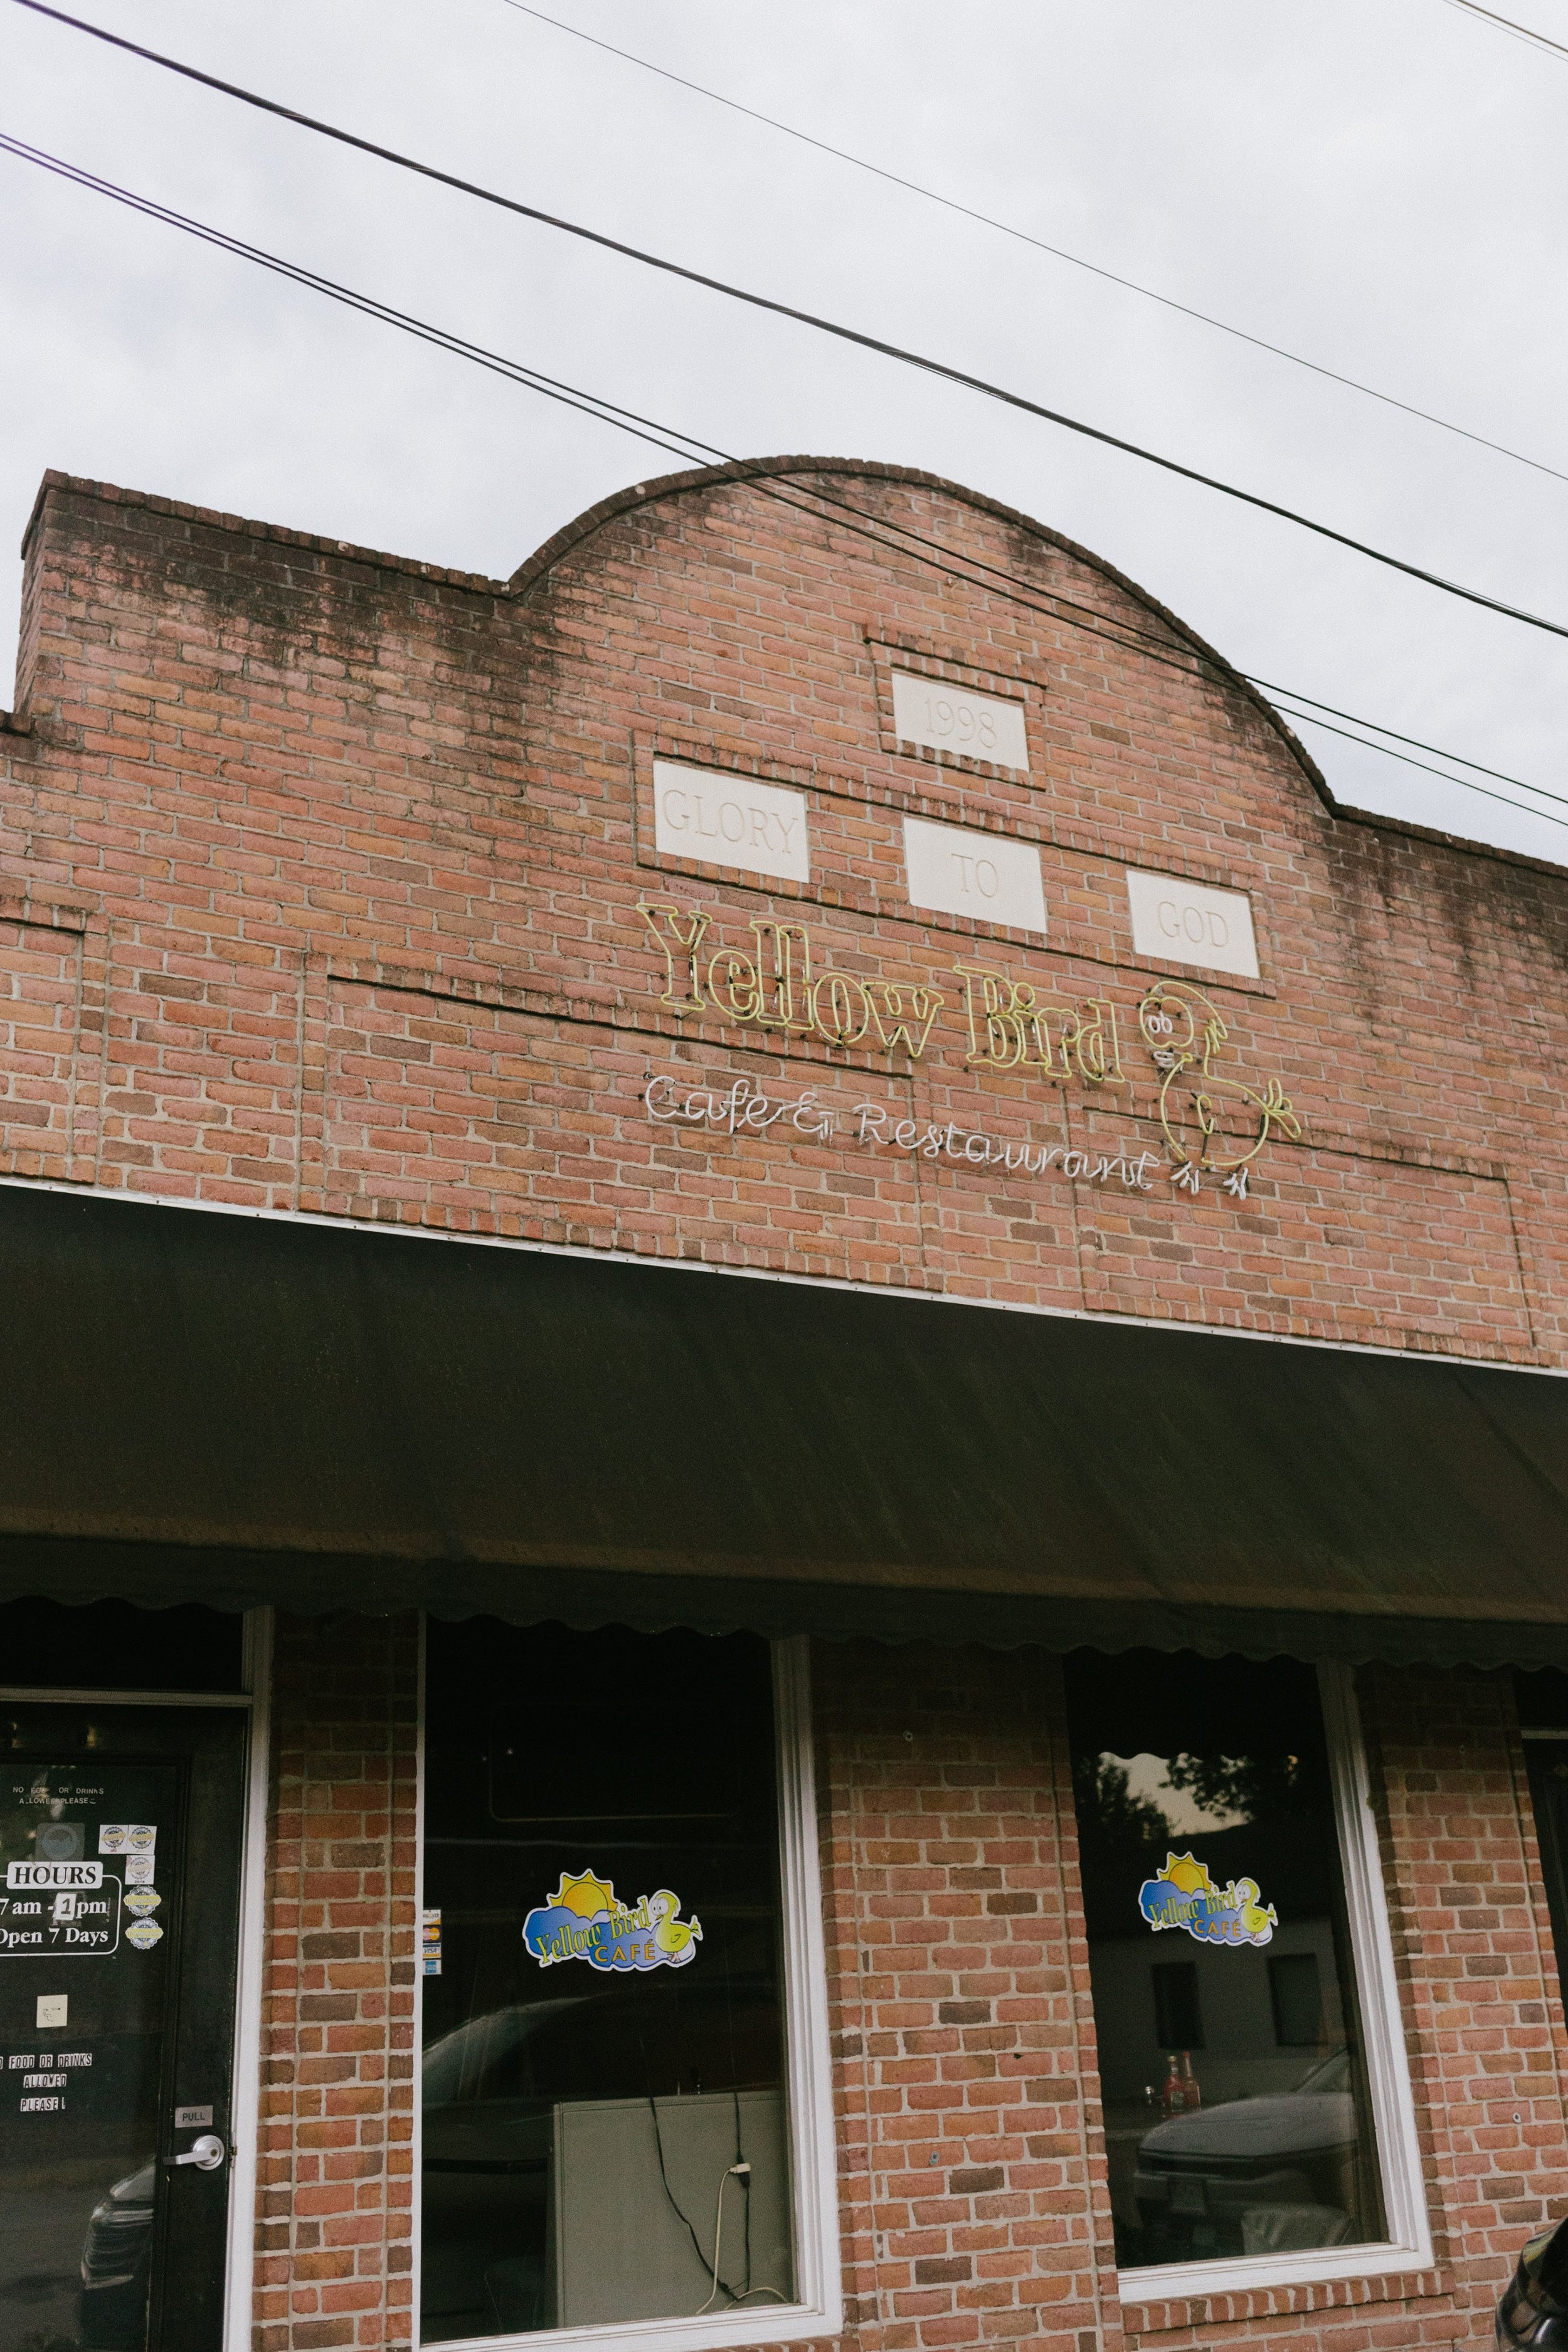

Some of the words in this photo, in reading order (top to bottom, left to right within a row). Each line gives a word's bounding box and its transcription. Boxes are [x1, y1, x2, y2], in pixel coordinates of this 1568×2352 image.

[924, 697, 997, 750] 1998
[662, 788, 799, 855] GLORY
[950, 852, 999, 899] TO
[1158, 899, 1229, 949] GOD
[635, 903, 945, 1058] Yellow
[953, 965, 1125, 1083] Bird
[645, 1076, 784, 1135] Cafe
[793, 1091, 835, 1143] &
[851, 1103, 1160, 1190] Restaurant
[13, 1866, 97, 1885] HOURS
[12, 1901, 42, 1915] am
[1148, 1897, 1199, 1929] Yellow
[1204, 1882, 1238, 1915] Bird
[0, 1928, 43, 1948] Open
[48, 1927, 60, 1944] 7
[65, 1927, 109, 1947] Days
[535, 1924, 602, 1964] Yellow
[607, 1898, 652, 1941] Bird
[1194, 1919, 1242, 1937] CAFÉ
[594, 1939, 656, 1963] CAFÉ
[10, 2057, 34, 2069] FOOD
[41, 2056, 52, 2067] OR
[58, 2054, 91, 2067] DRINKS
[24, 2075, 66, 2087] ALLOWED
[21, 2098, 58, 2111] PLEASE
[182, 2112, 206, 2122] PULL
